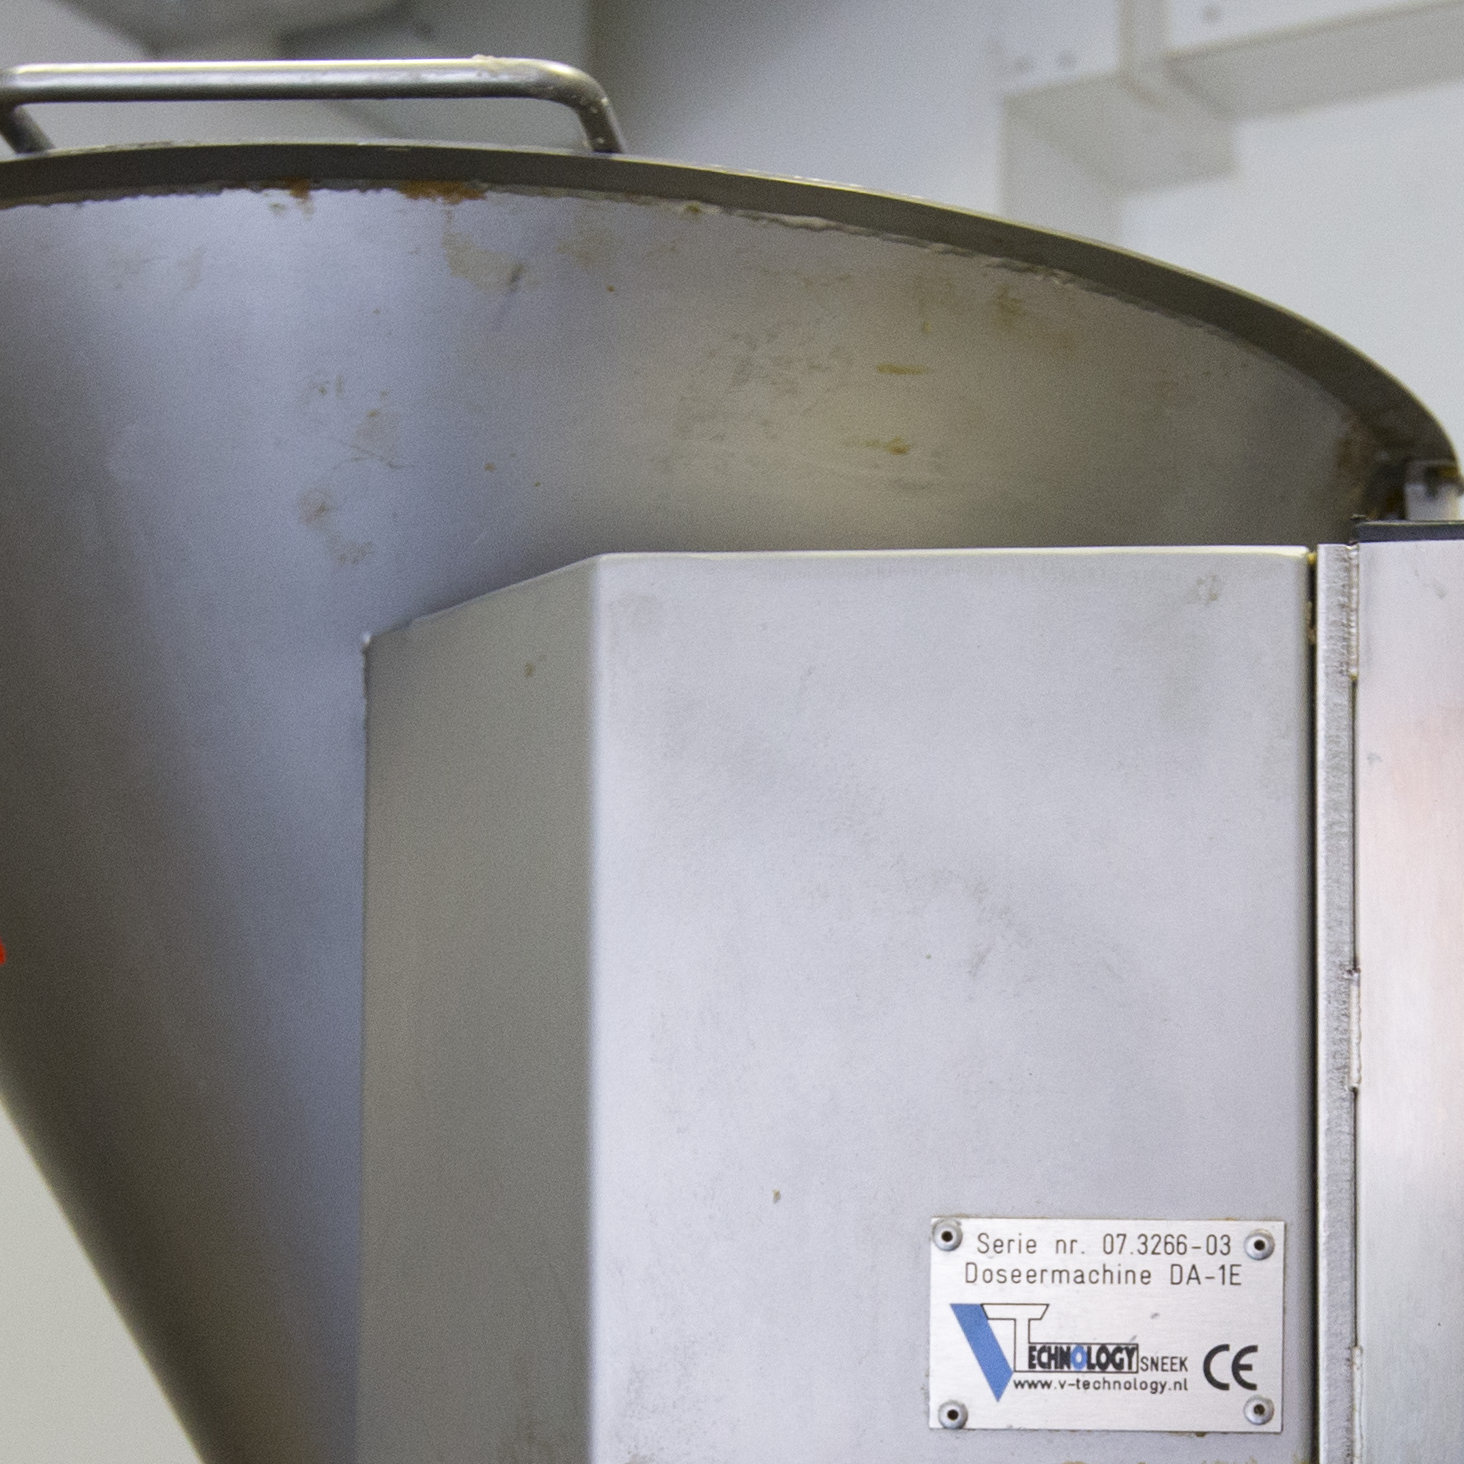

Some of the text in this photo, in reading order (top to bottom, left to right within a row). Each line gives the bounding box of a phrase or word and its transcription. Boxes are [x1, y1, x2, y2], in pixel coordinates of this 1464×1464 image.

[976, 1233, 1231, 1256] Serie nr. 07.3266-03
[965, 1262, 1242, 1286] Doseermachine DA-1E
[1141, 1356, 1188, 1372] SNEEK
[1014, 1378, 1188, 1394] www.v-technology.nl
